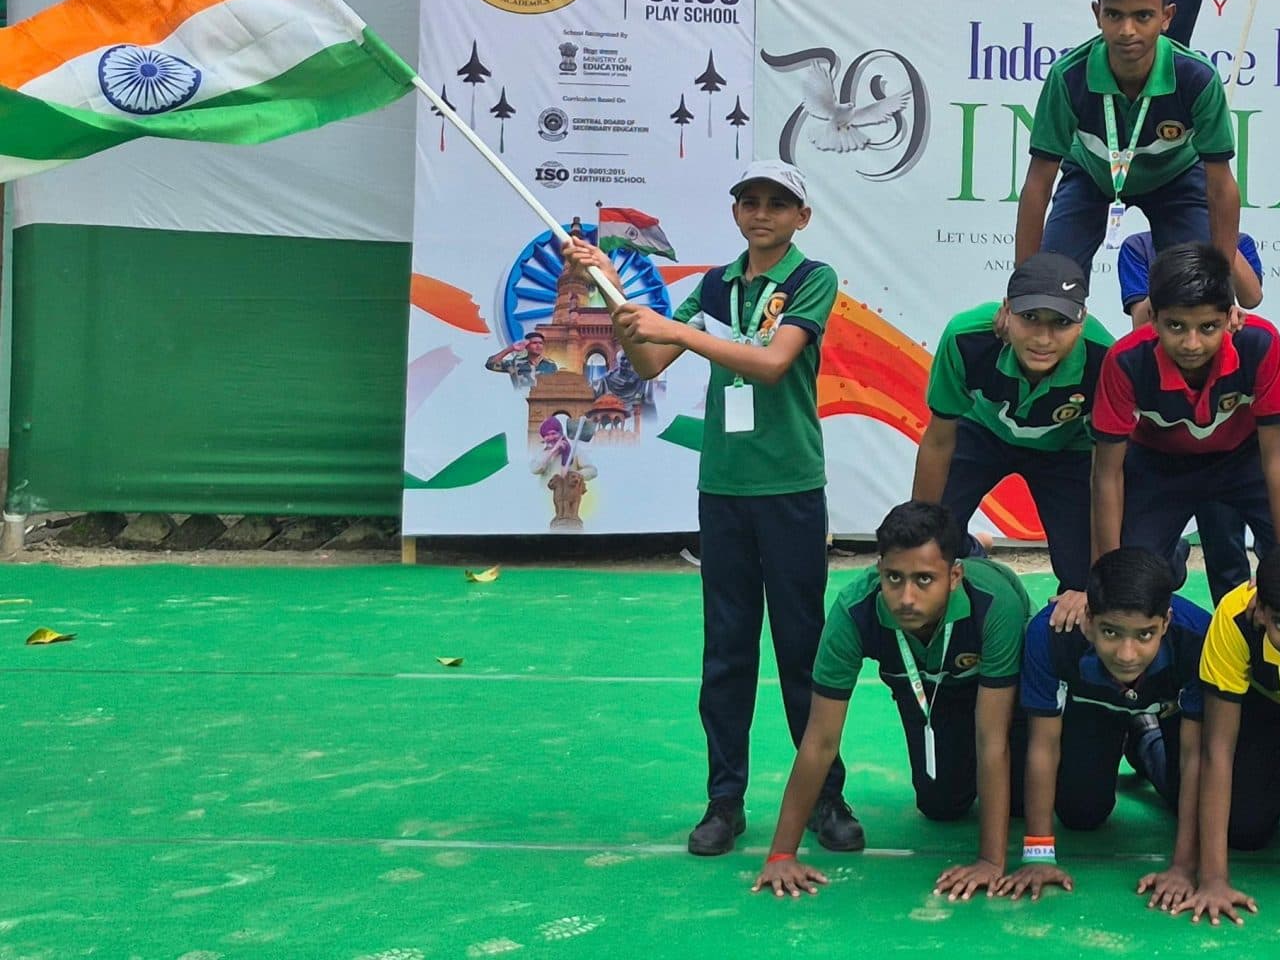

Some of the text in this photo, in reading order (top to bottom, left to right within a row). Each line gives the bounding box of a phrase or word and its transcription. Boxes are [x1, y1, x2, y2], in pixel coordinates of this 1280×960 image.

[645, 5, 740, 25] PLAY SCHOOL
[968, 21, 1256, 86] Indece
[583, 63, 632, 72] EDUCATION
[760, 47, 931, 181] 79
[535, 167, 570, 181] ISO
[573, 167, 587, 175] ISO
[573, 175, 647, 184] CERTIFIED SCHOOL
[936, 229, 965, 243] LET
[970, 233, 988, 244] US
